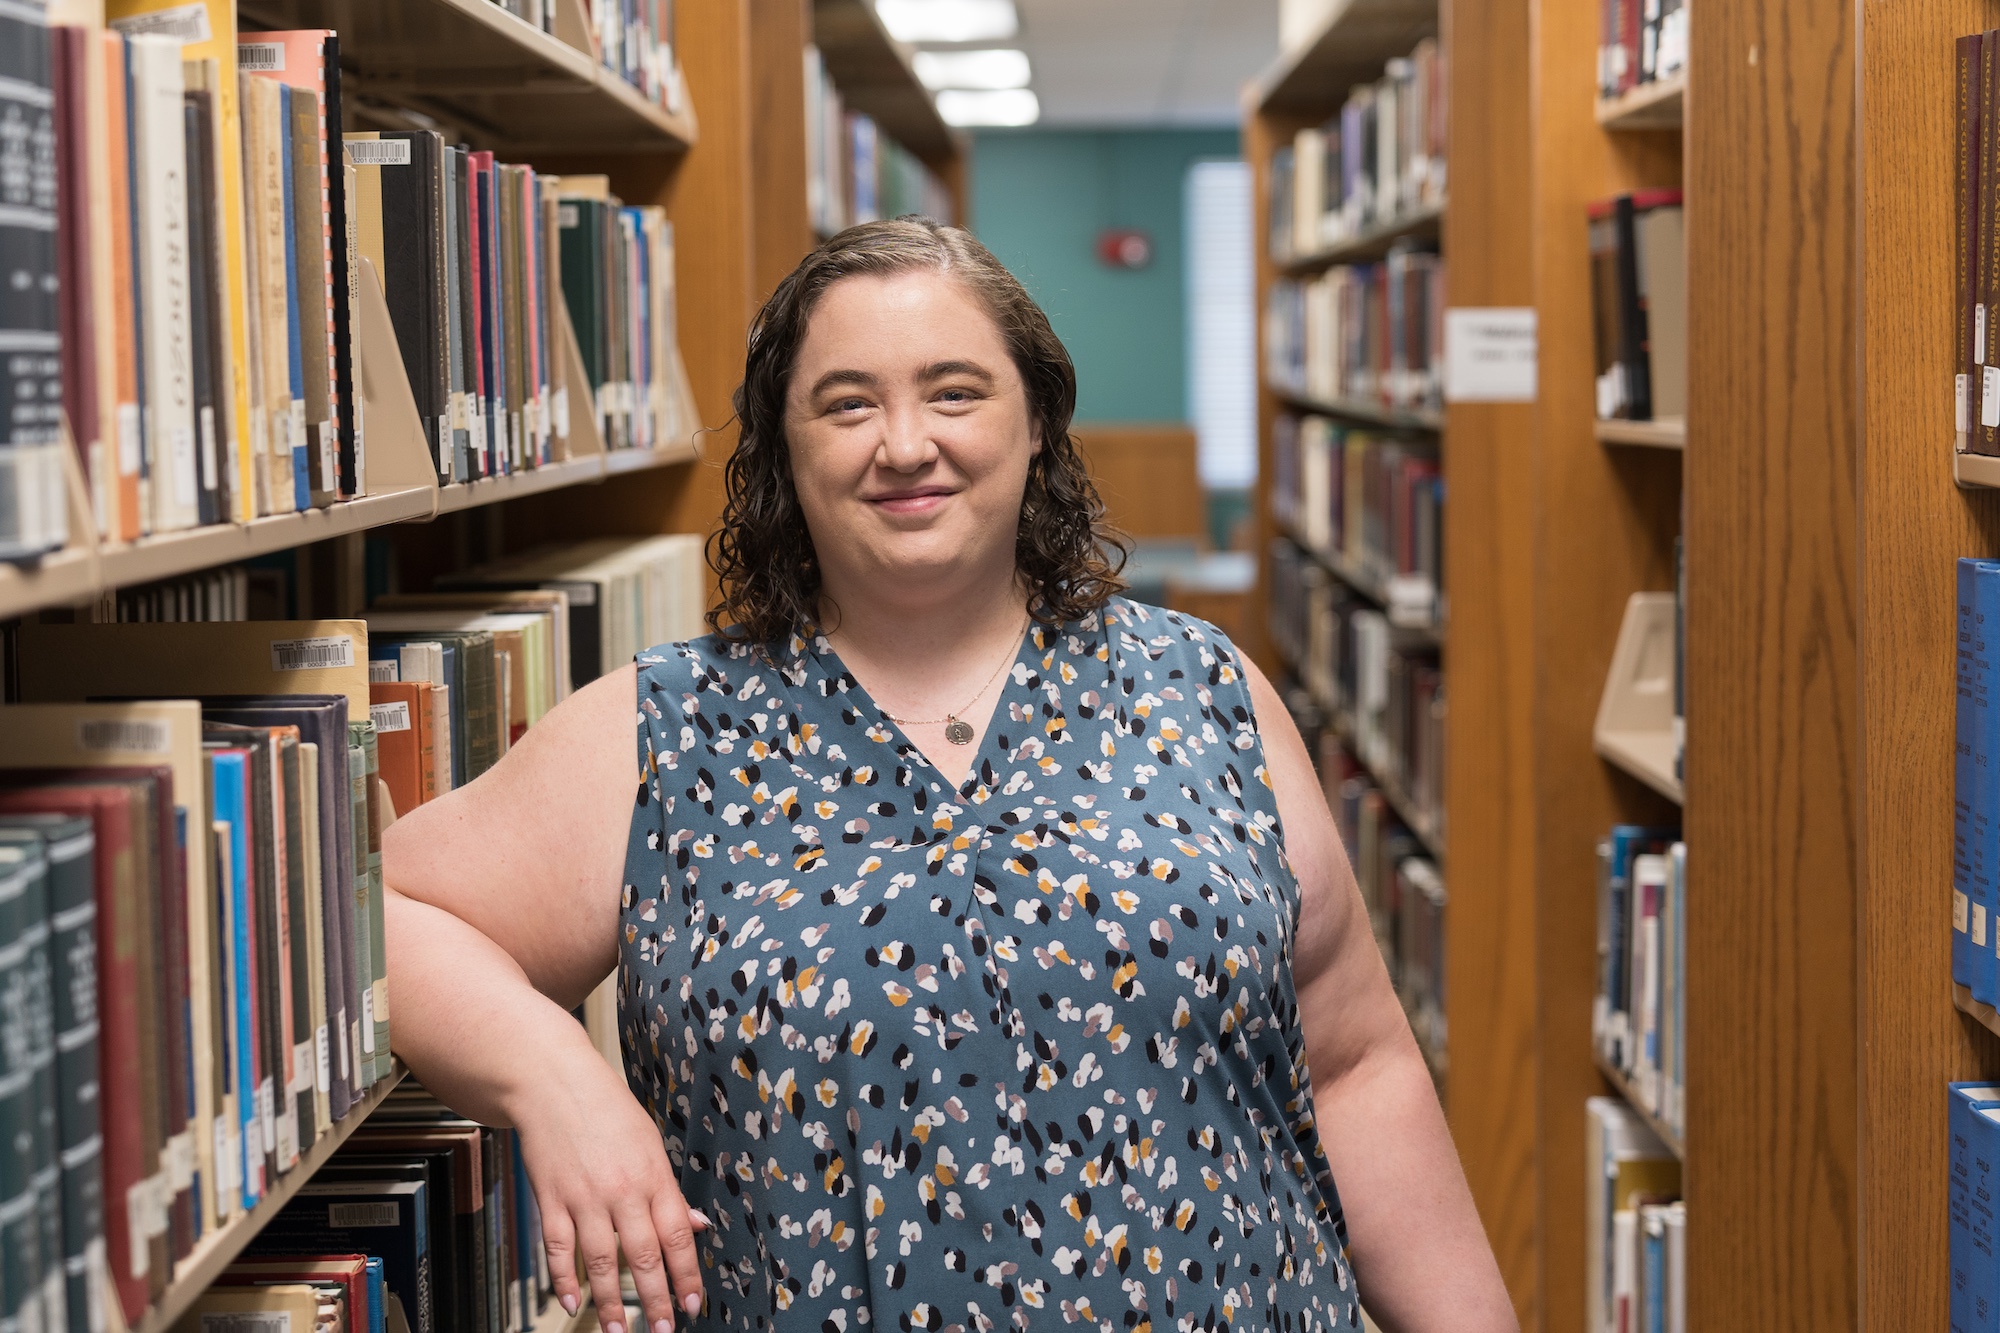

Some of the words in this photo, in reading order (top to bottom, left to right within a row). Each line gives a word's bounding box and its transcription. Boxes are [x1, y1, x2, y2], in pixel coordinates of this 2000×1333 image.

[1992, 183, 2000, 292] CASEBOOK
[165, 171, 188, 407] CARDOZO
[1989, 303, 1998, 365] Volume
[1958, 1150, 1964, 1162] C
[1976, 1157, 1990, 1174] PHILIP
[1980, 1174, 1986, 1186] C
[1976, 1186, 1990, 1202] JESSUP
[1972, 1198, 1994, 1221] INTERNATIONAL
[1974, 1225, 1982, 1238] MOOT
[1983, 1232, 1993, 1245] COURT
[1973, 1237, 1992, 1258] COMPETITION
[1976, 1294, 1988, 1313] 1983
